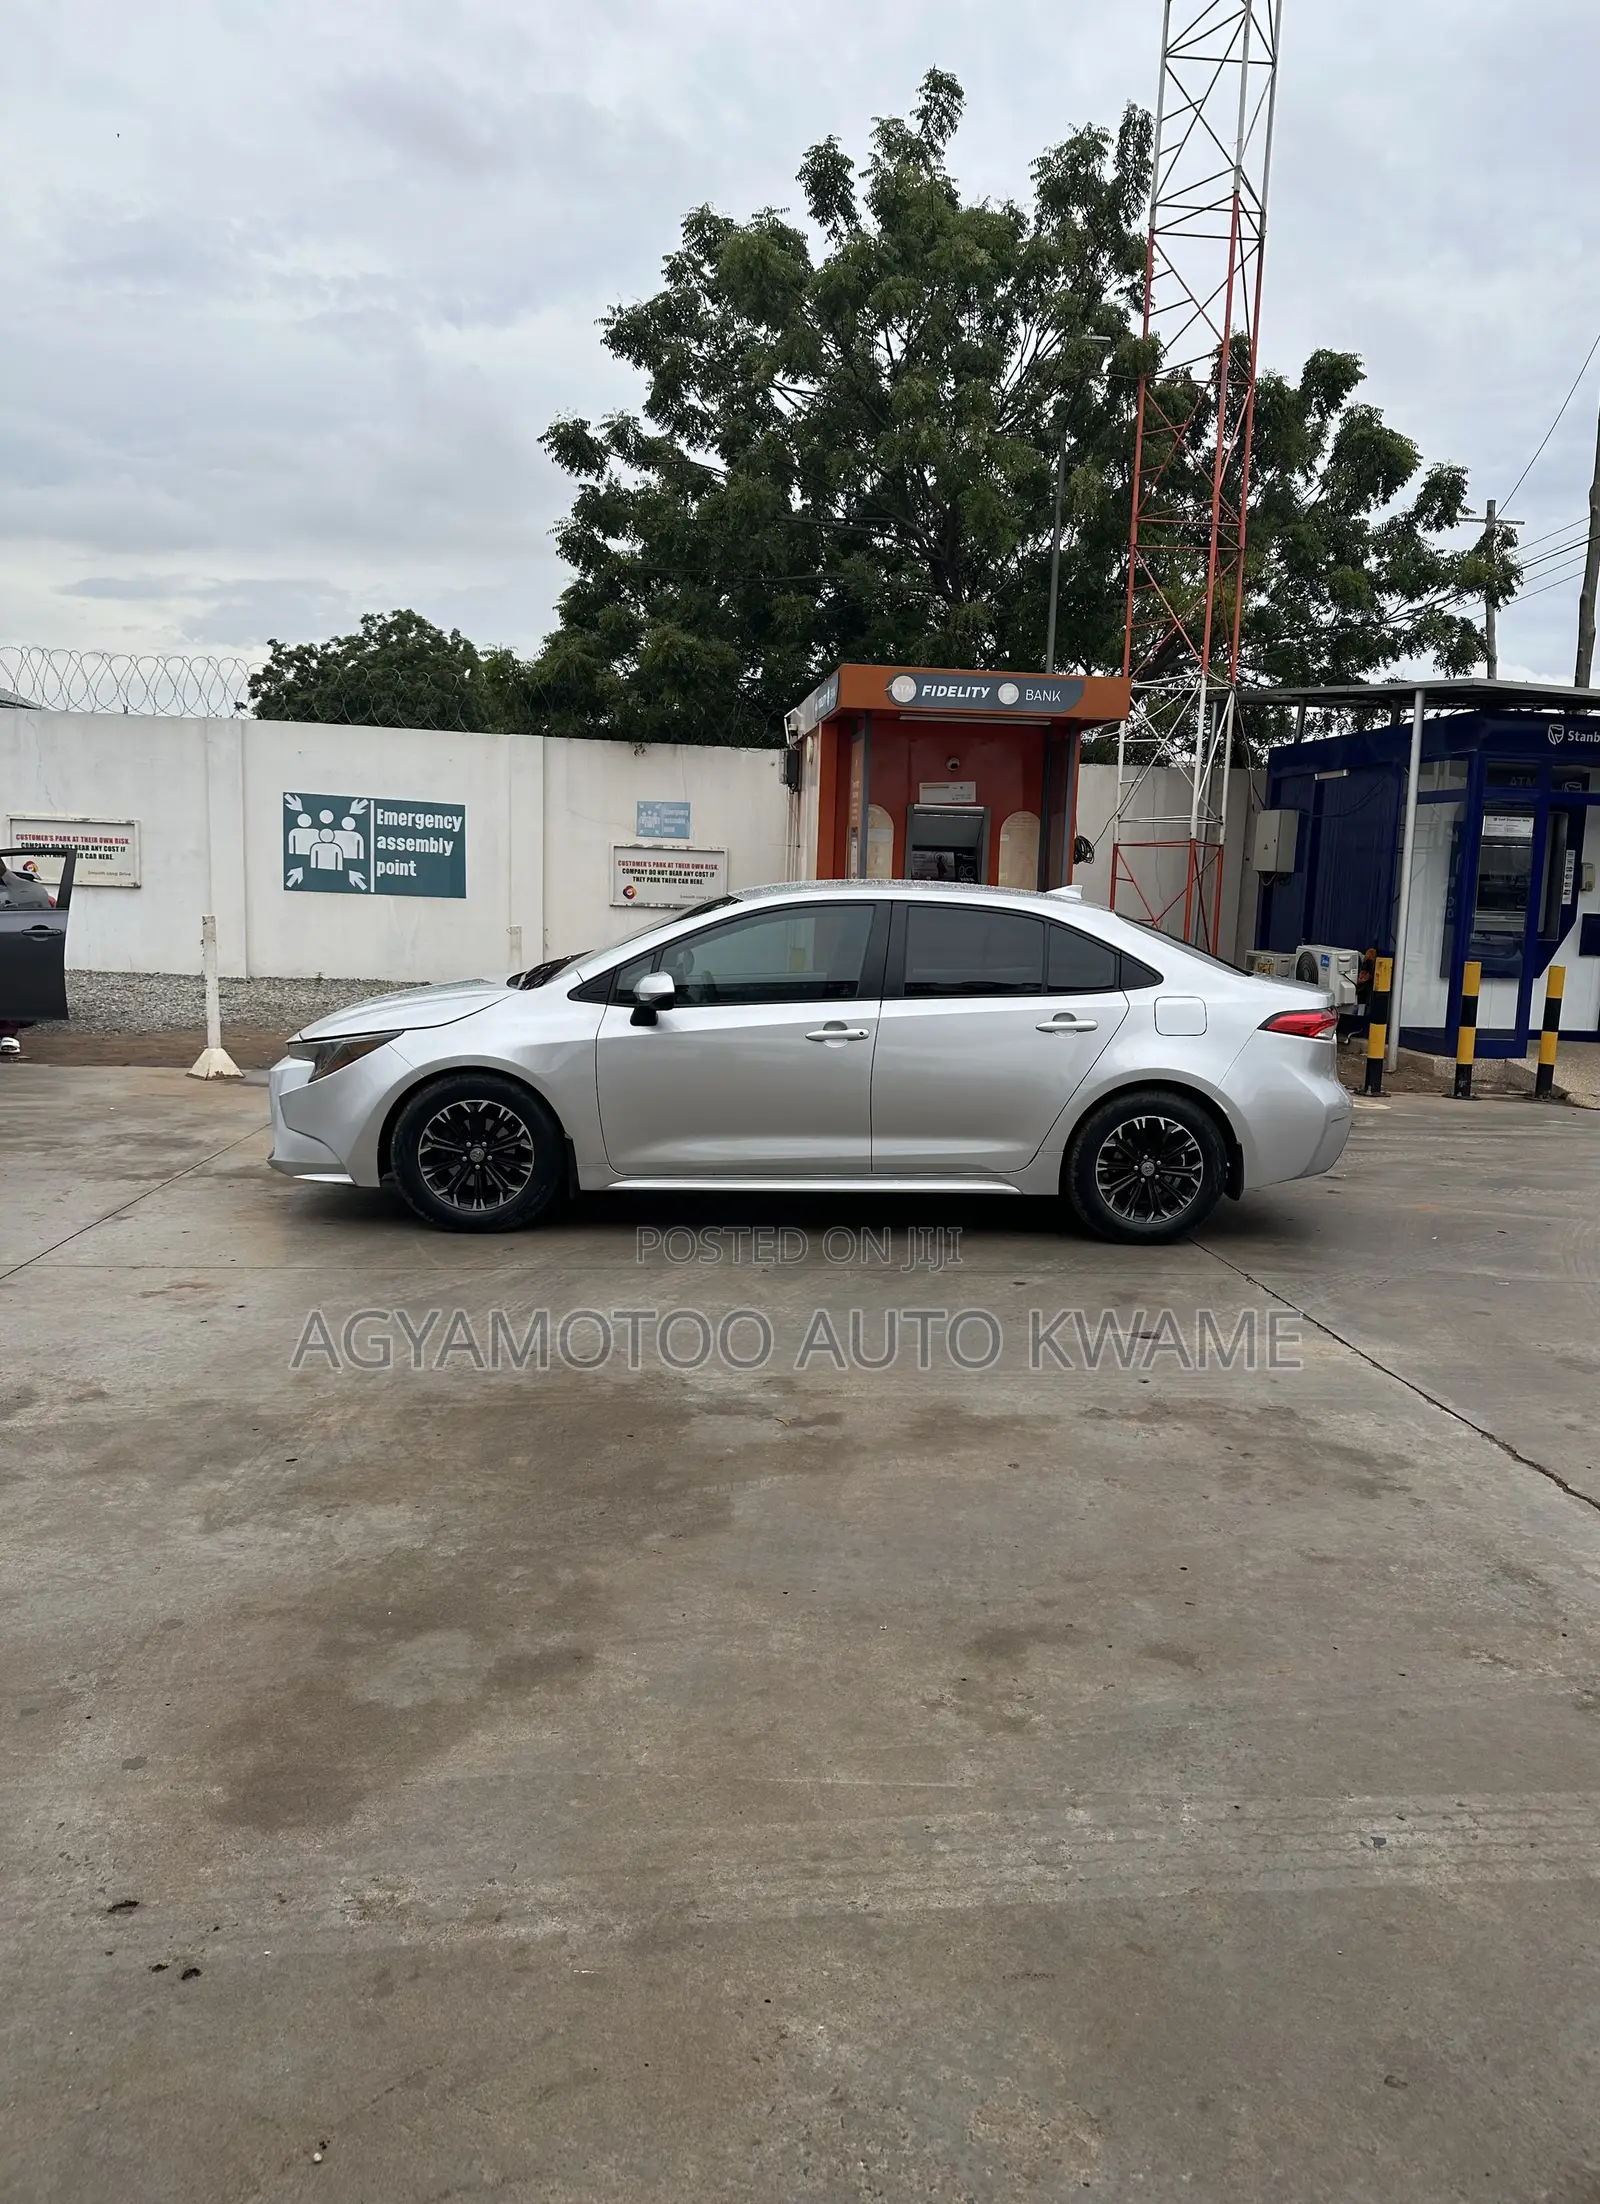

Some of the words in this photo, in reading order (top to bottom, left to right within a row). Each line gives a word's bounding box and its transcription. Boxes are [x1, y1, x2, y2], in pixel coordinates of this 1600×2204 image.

[921, 685, 990, 698] FIDELITY
[1025, 689, 1061, 702] BANK
[376, 808, 463, 832] Emergency
[103, 845, 120, 853] COST
[376, 836, 454, 856] assembly
[376, 859, 417, 877] point
